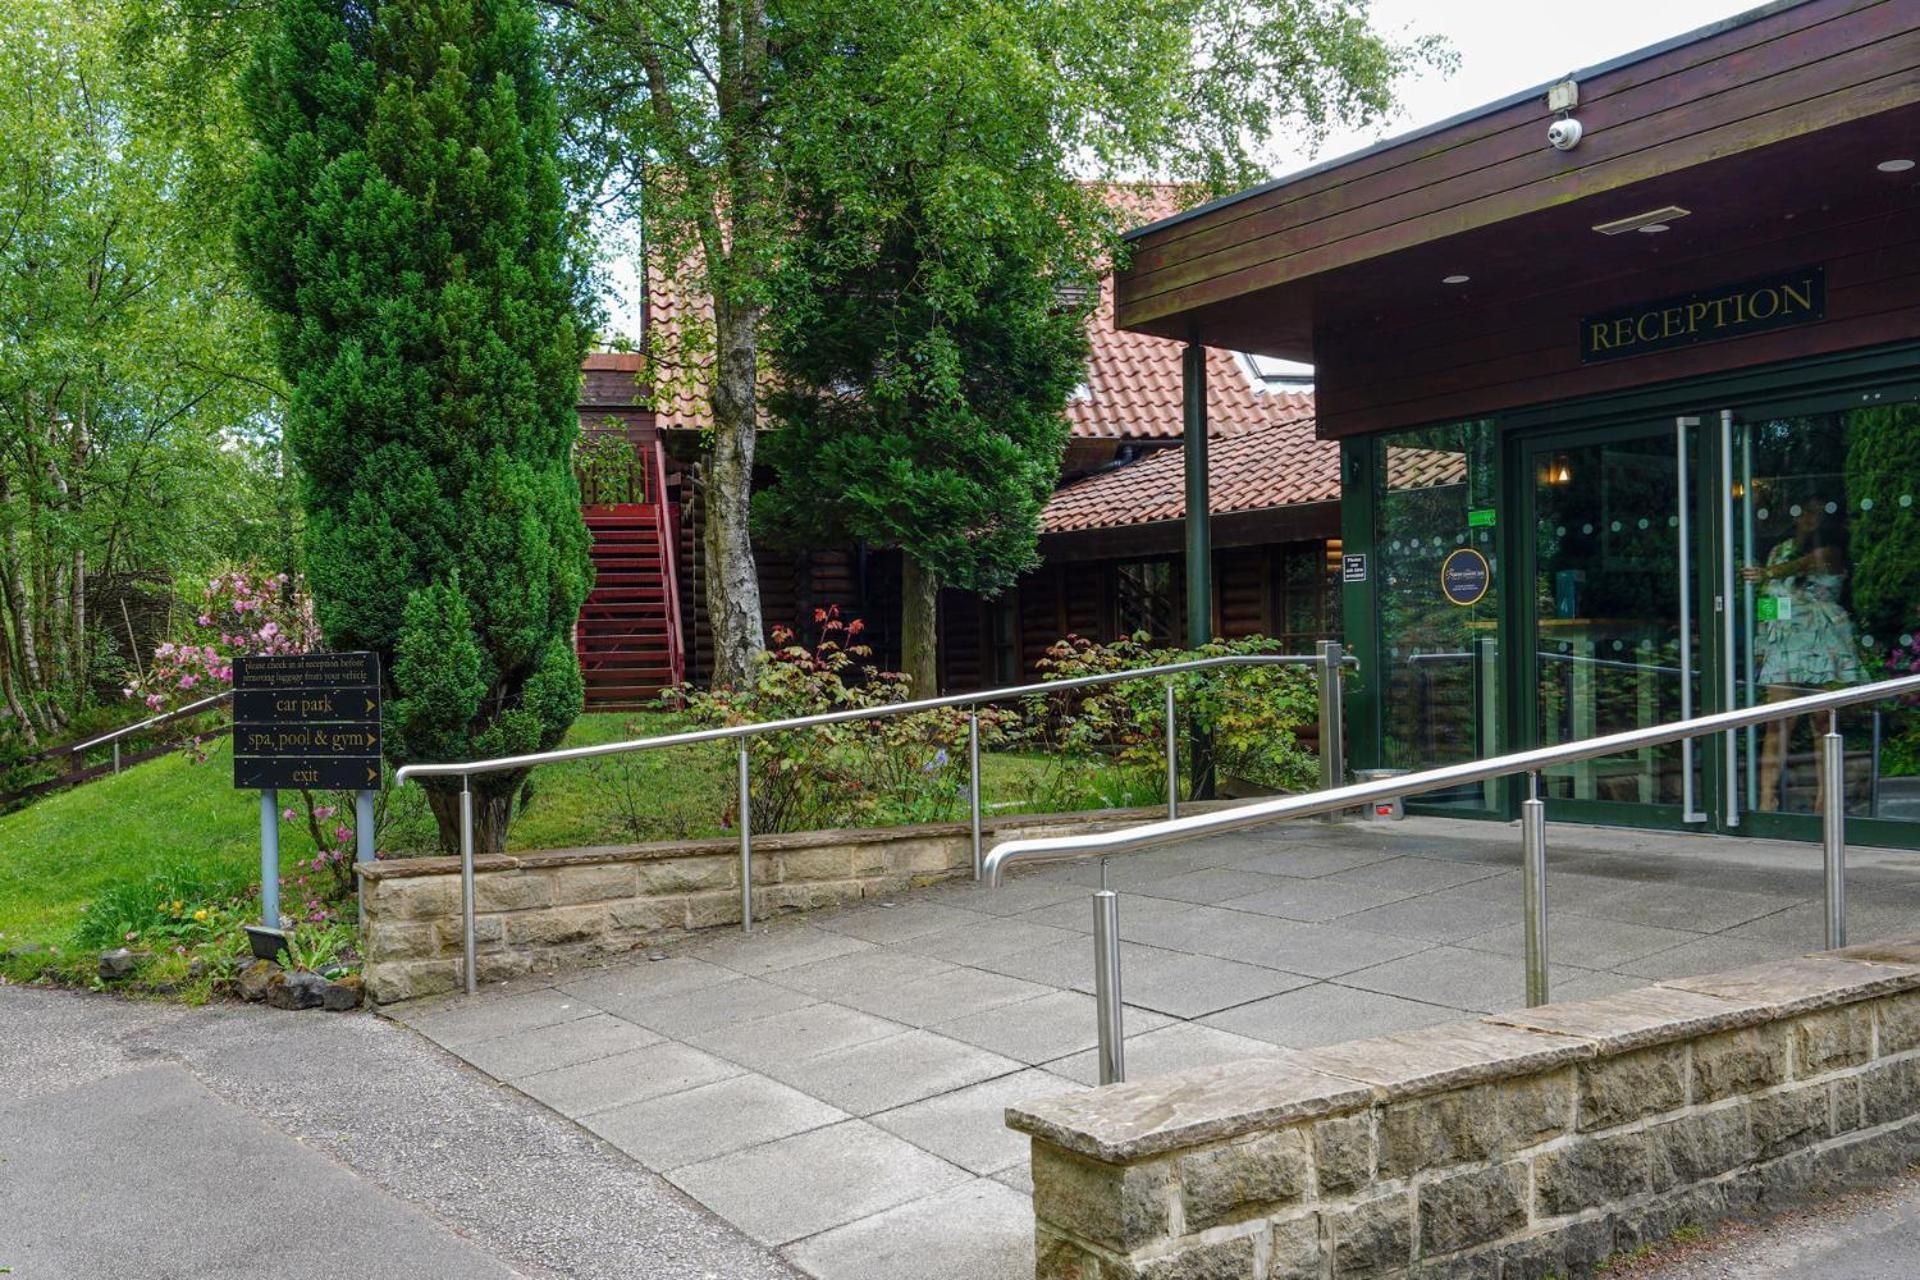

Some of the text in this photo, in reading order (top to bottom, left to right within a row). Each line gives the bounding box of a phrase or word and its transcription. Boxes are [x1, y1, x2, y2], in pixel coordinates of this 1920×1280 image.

[1590, 279, 1813, 351] RECEPTION
[245, 658, 365, 673] please check in at reception before
[242, 670, 368, 685] removing luggage from your vehicle
[276, 694, 333, 717] car park
[248, 728, 364, 751] spa, pool & gym
[292, 764, 319, 782] exit
